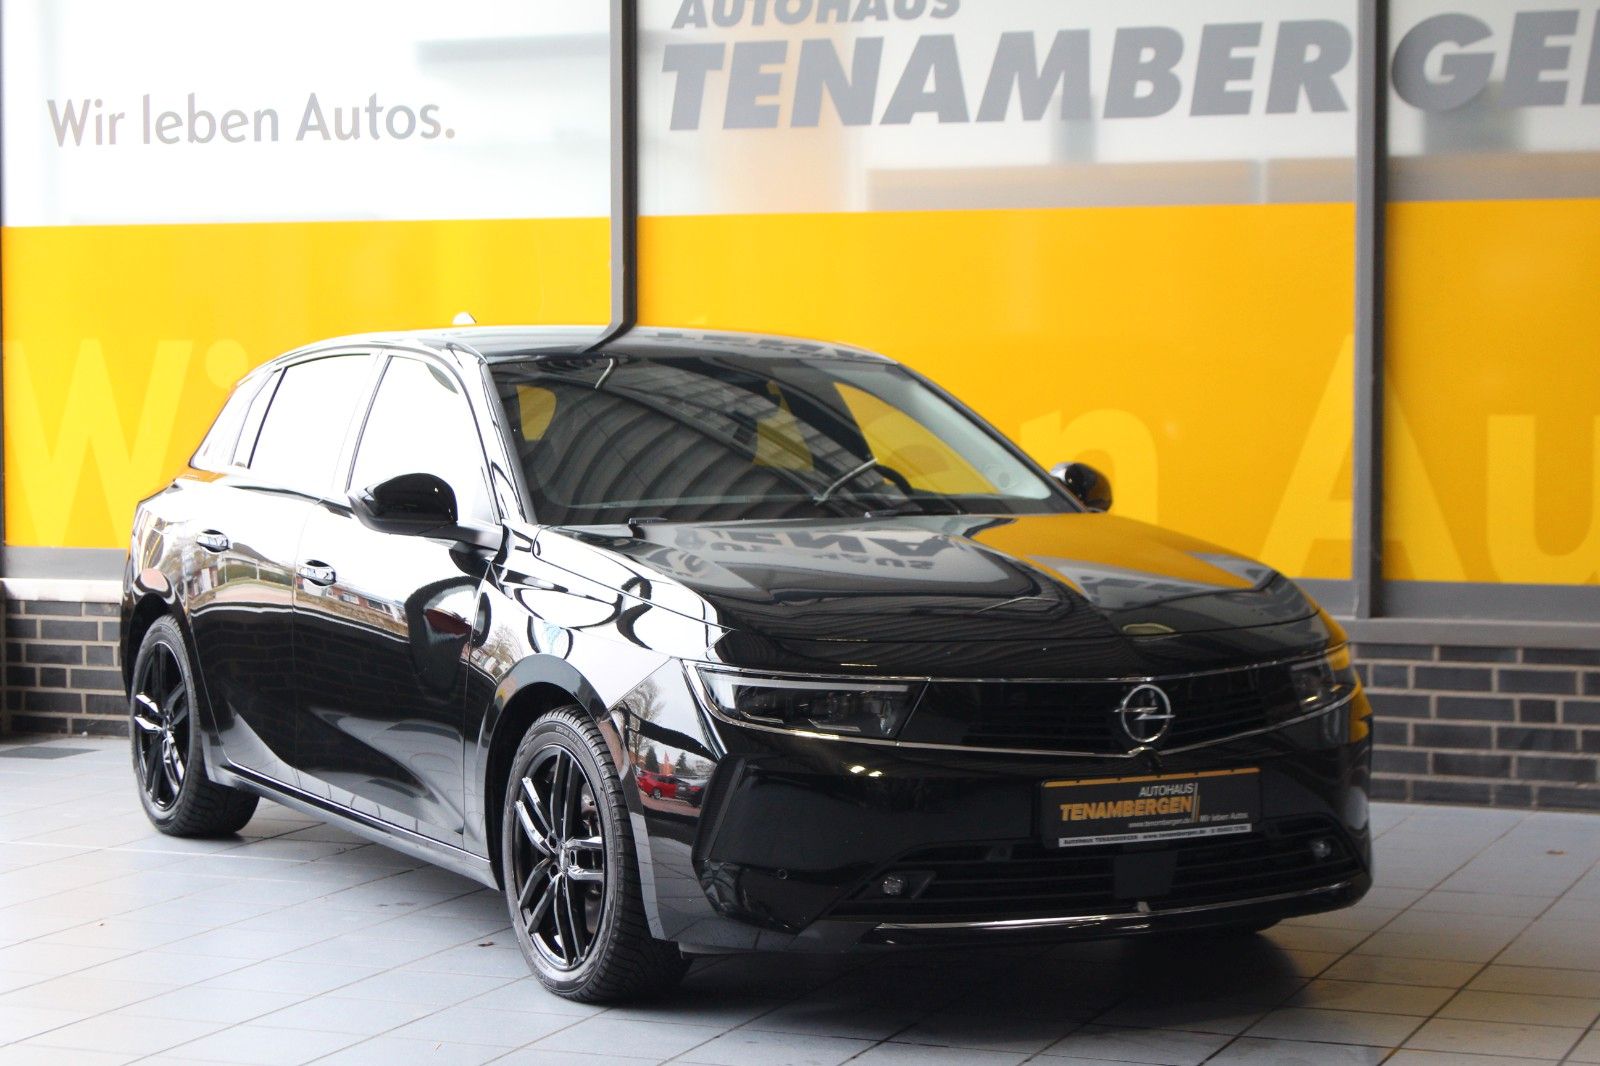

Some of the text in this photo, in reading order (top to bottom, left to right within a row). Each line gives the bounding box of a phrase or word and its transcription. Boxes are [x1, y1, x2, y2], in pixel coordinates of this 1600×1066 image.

[46, 91, 456, 147] Wir leben Autos.
[1139, 783, 1194, 797] AUTOHAUS
[1059, 797, 1193, 821] TENAMBERGEN
